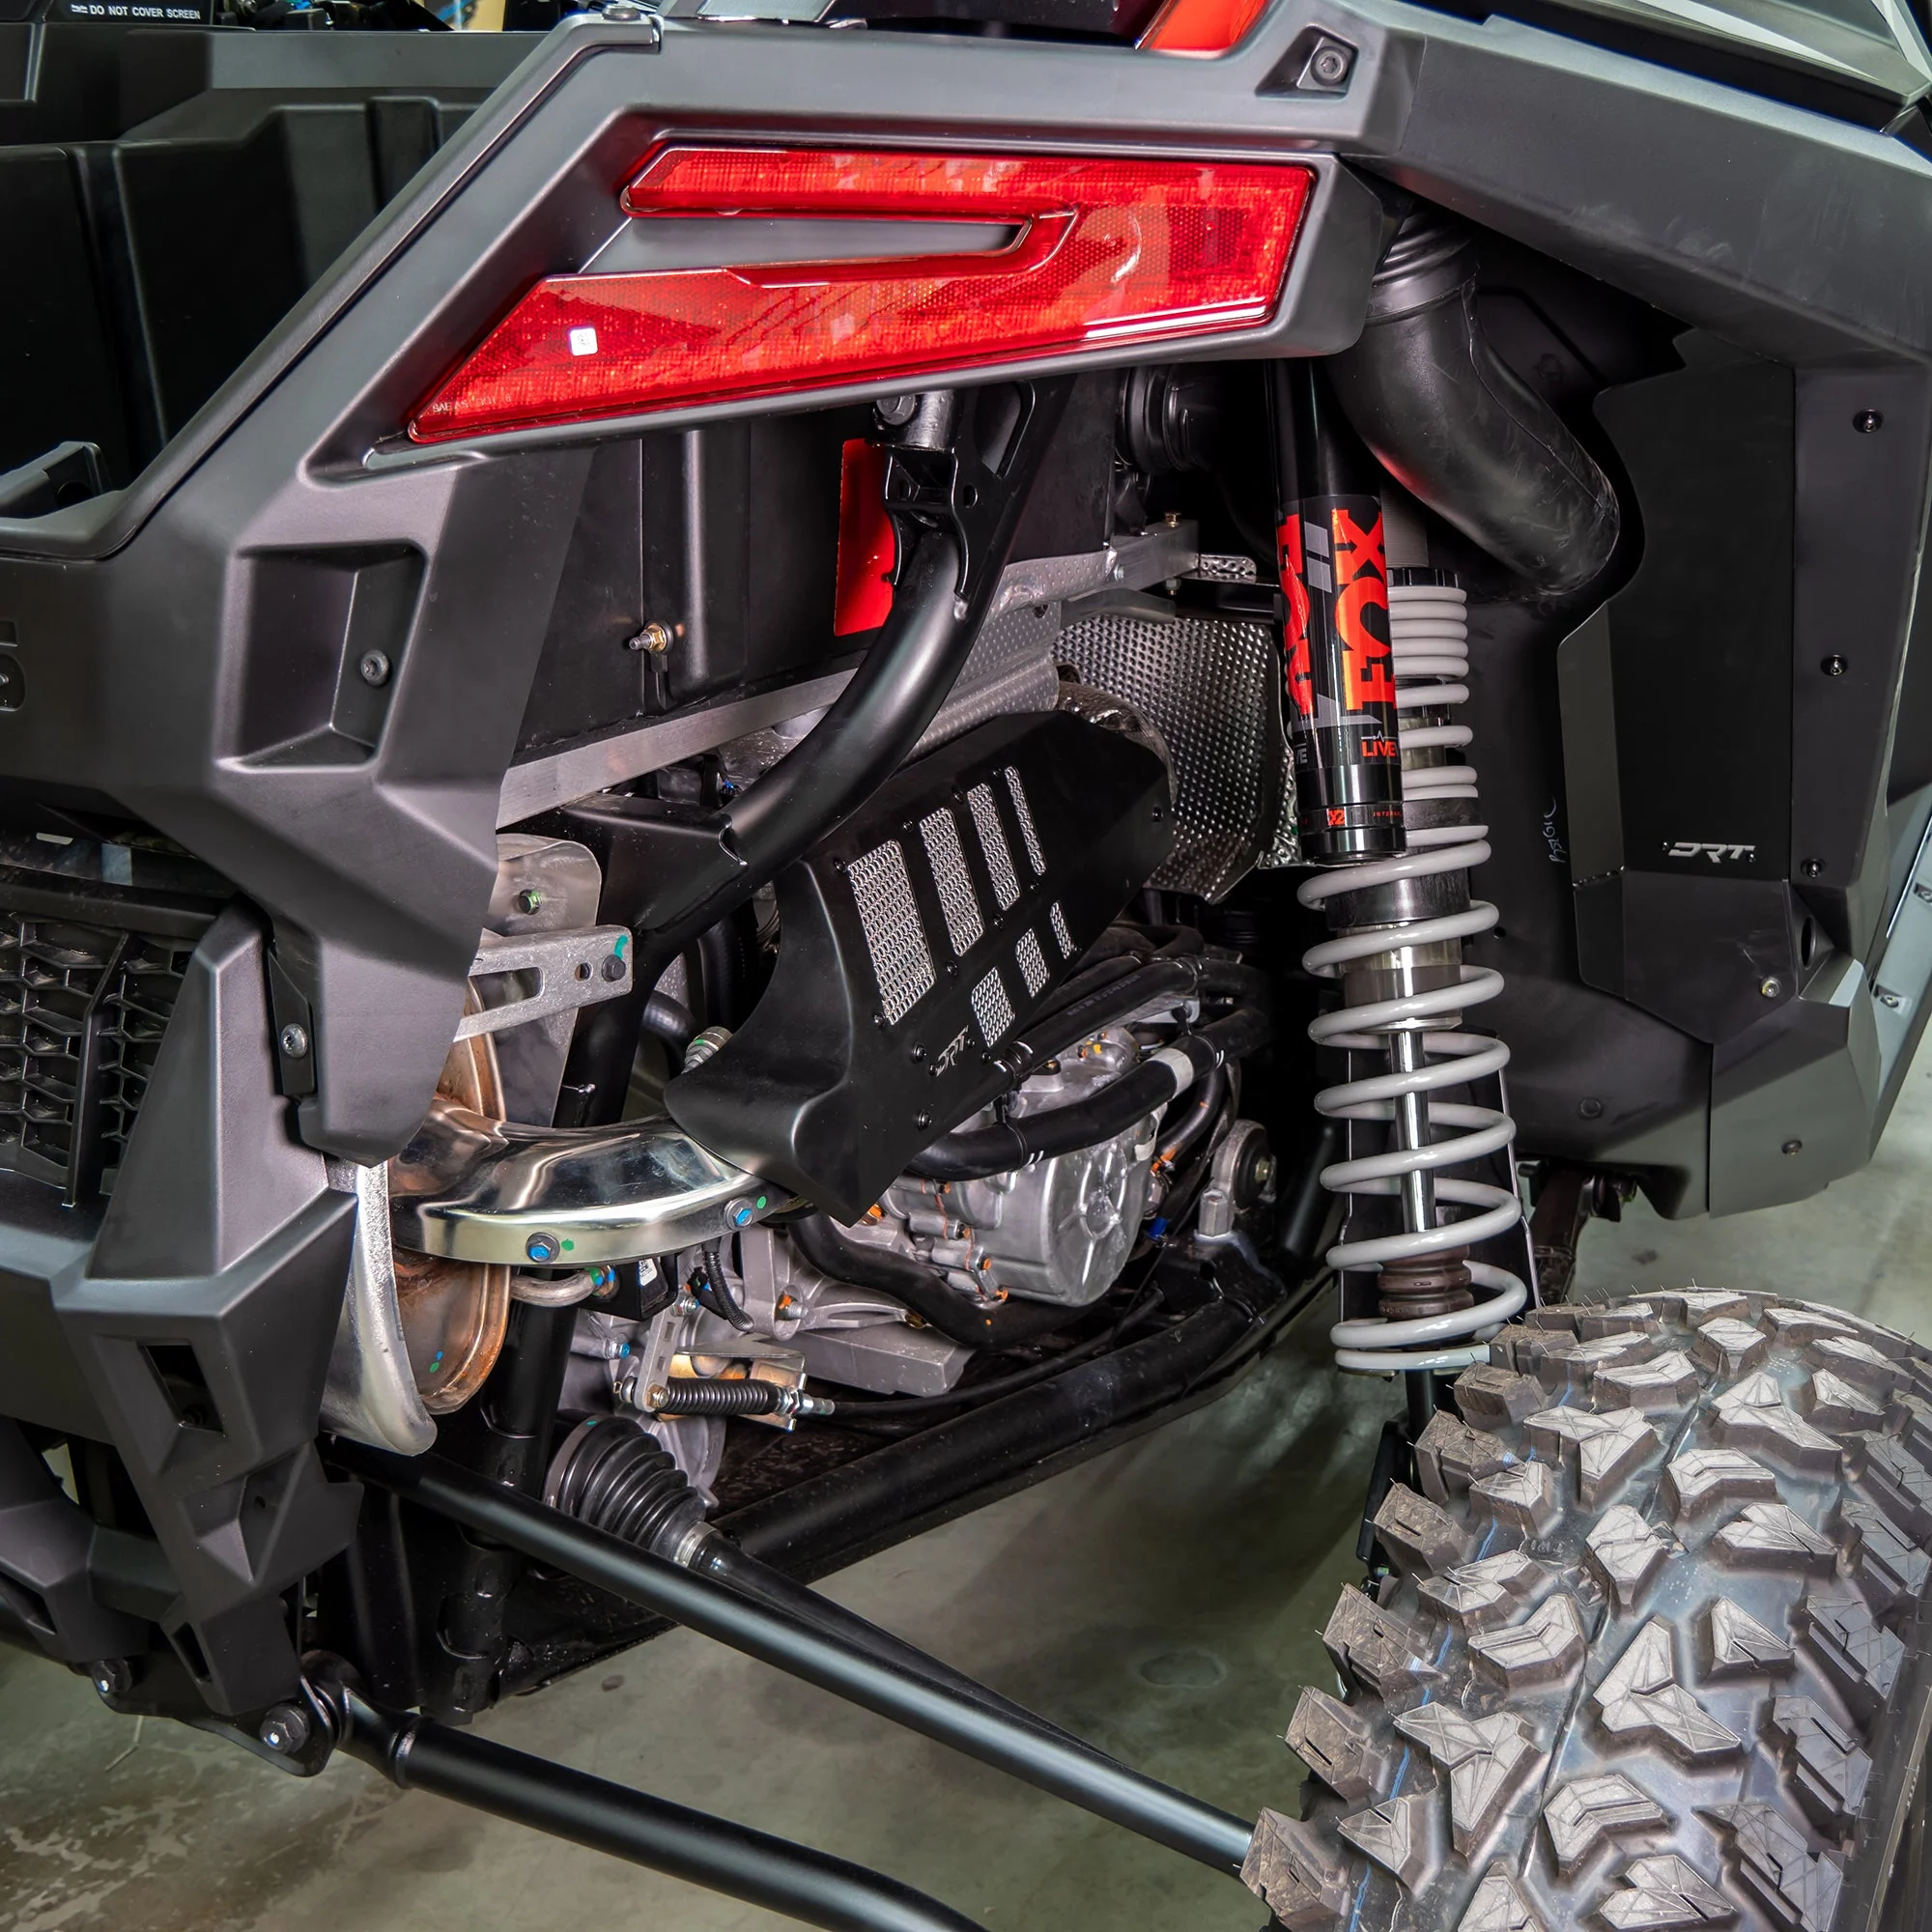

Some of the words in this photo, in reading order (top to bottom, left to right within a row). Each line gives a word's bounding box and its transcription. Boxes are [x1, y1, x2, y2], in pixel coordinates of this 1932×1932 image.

[89, 4, 105, 15] DO
[108, 6, 128, 16] NOT
[131, 7, 164, 18] COVER
[166, 9, 202, 20] SCREEN
[1332, 508, 1398, 711] FOX
[1361, 740, 1397, 758] LIVE
